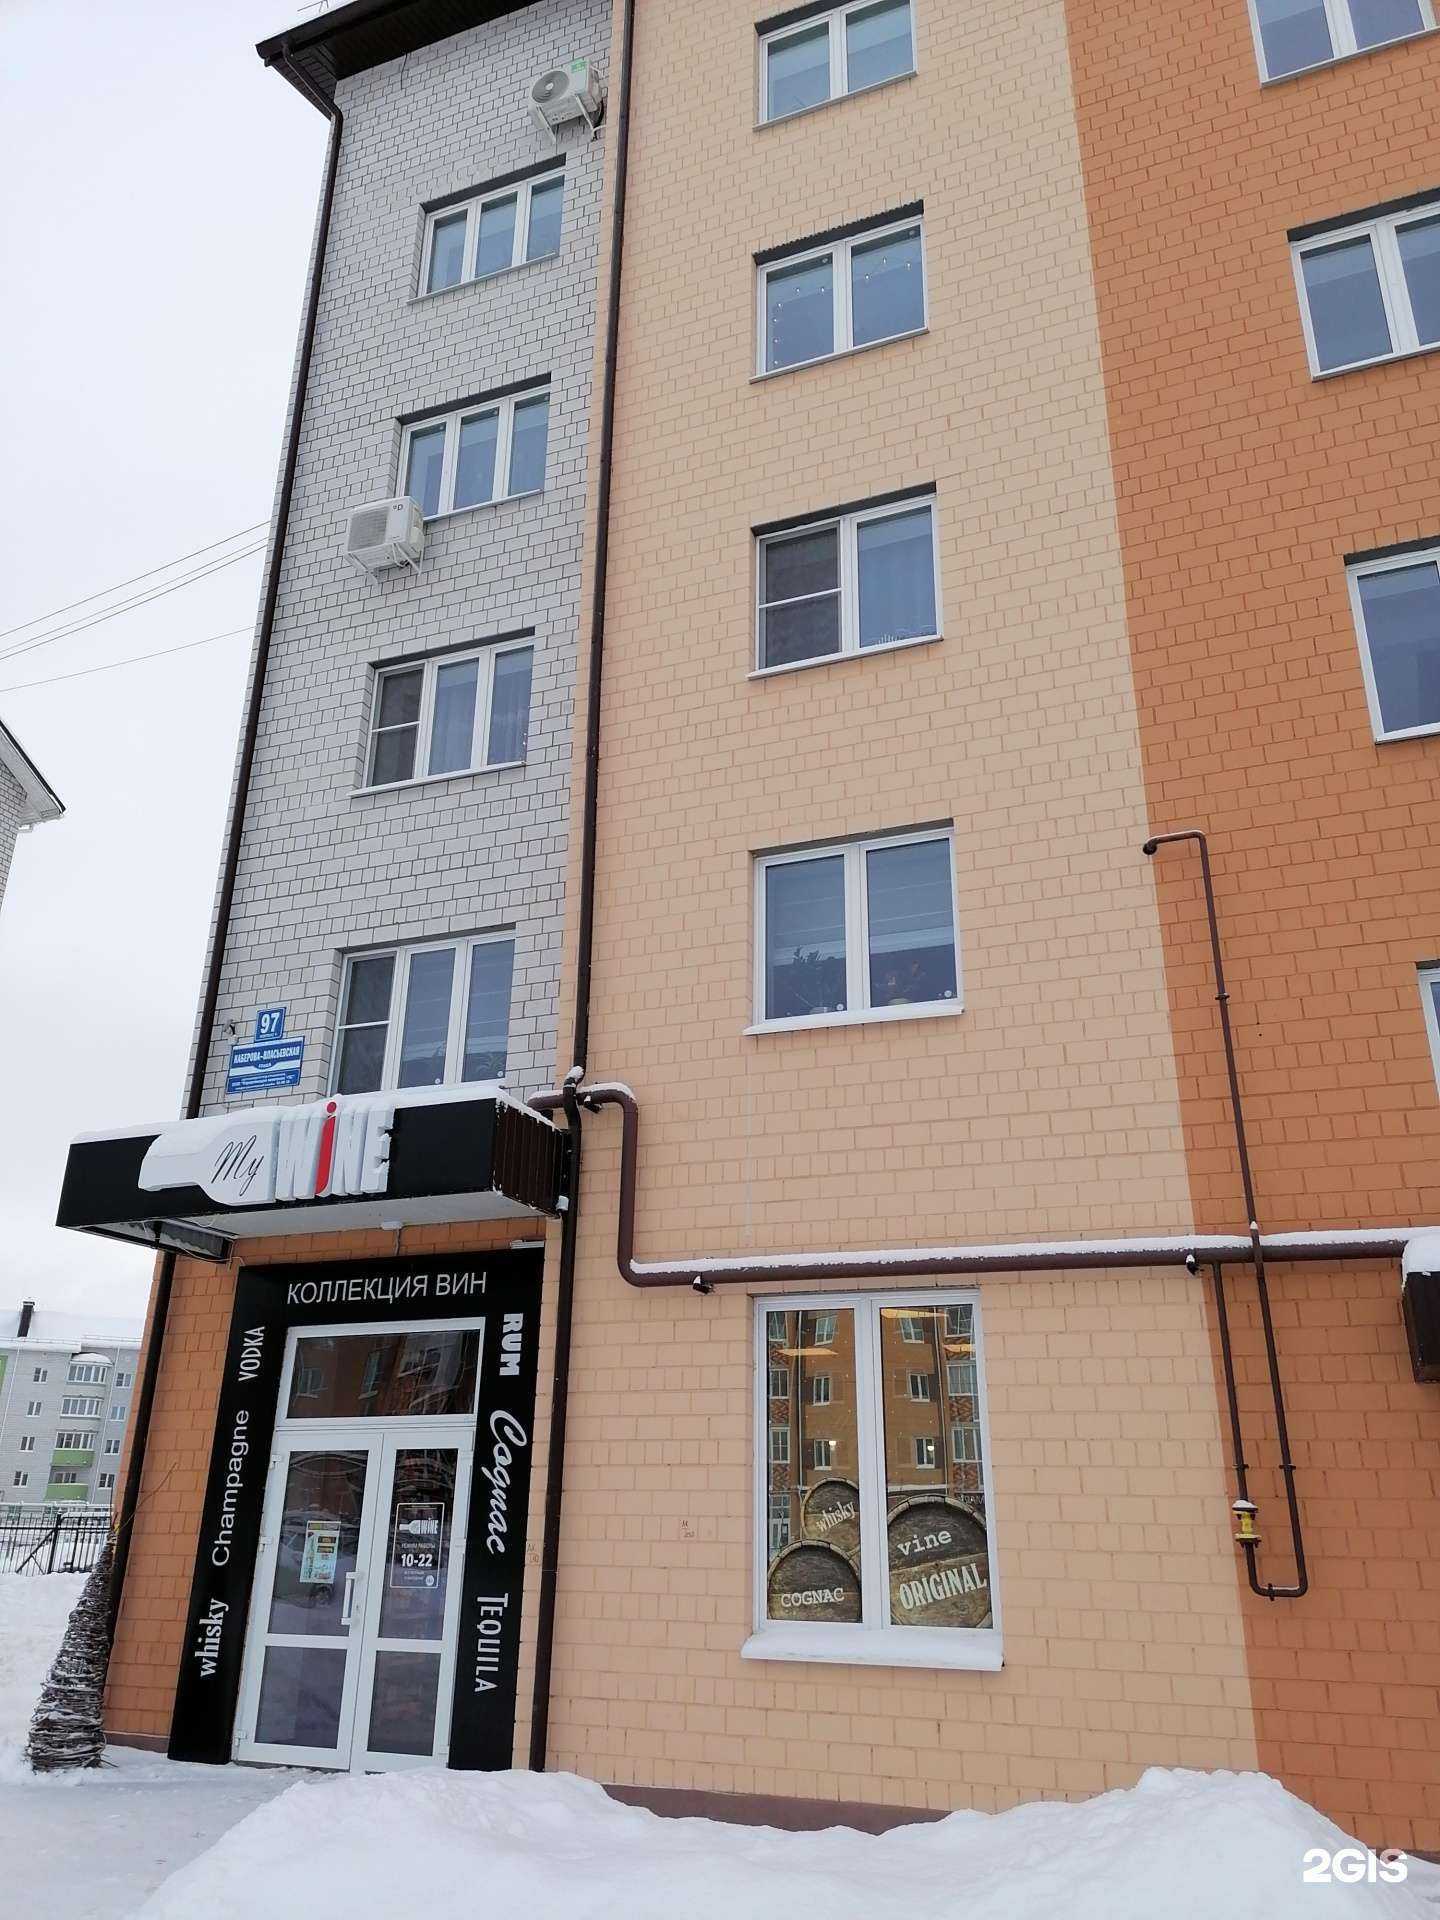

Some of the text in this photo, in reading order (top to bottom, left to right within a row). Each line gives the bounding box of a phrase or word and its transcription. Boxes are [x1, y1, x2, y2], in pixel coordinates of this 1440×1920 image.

[261, 1012, 280, 1034] 97
[211, 1135, 264, 1197] My
[287, 1271, 487, 1304] КОЛЛЕКЦИЯ ВИН
[238, 1326, 265, 1382] VODKA
[500, 1312, 524, 1376] RUM
[212, 1409, 249, 1567] Champagne
[481, 1409, 528, 1554] Cognac
[816, 1500, 856, 1532] whisky
[897, 1529, 953, 1556] vine
[401, 1553, 433, 1567] 10-22
[781, 1587, 845, 1608] COGNAC
[195, 1598, 229, 1677] whisky
[475, 1593, 509, 1692] TEQUILA
